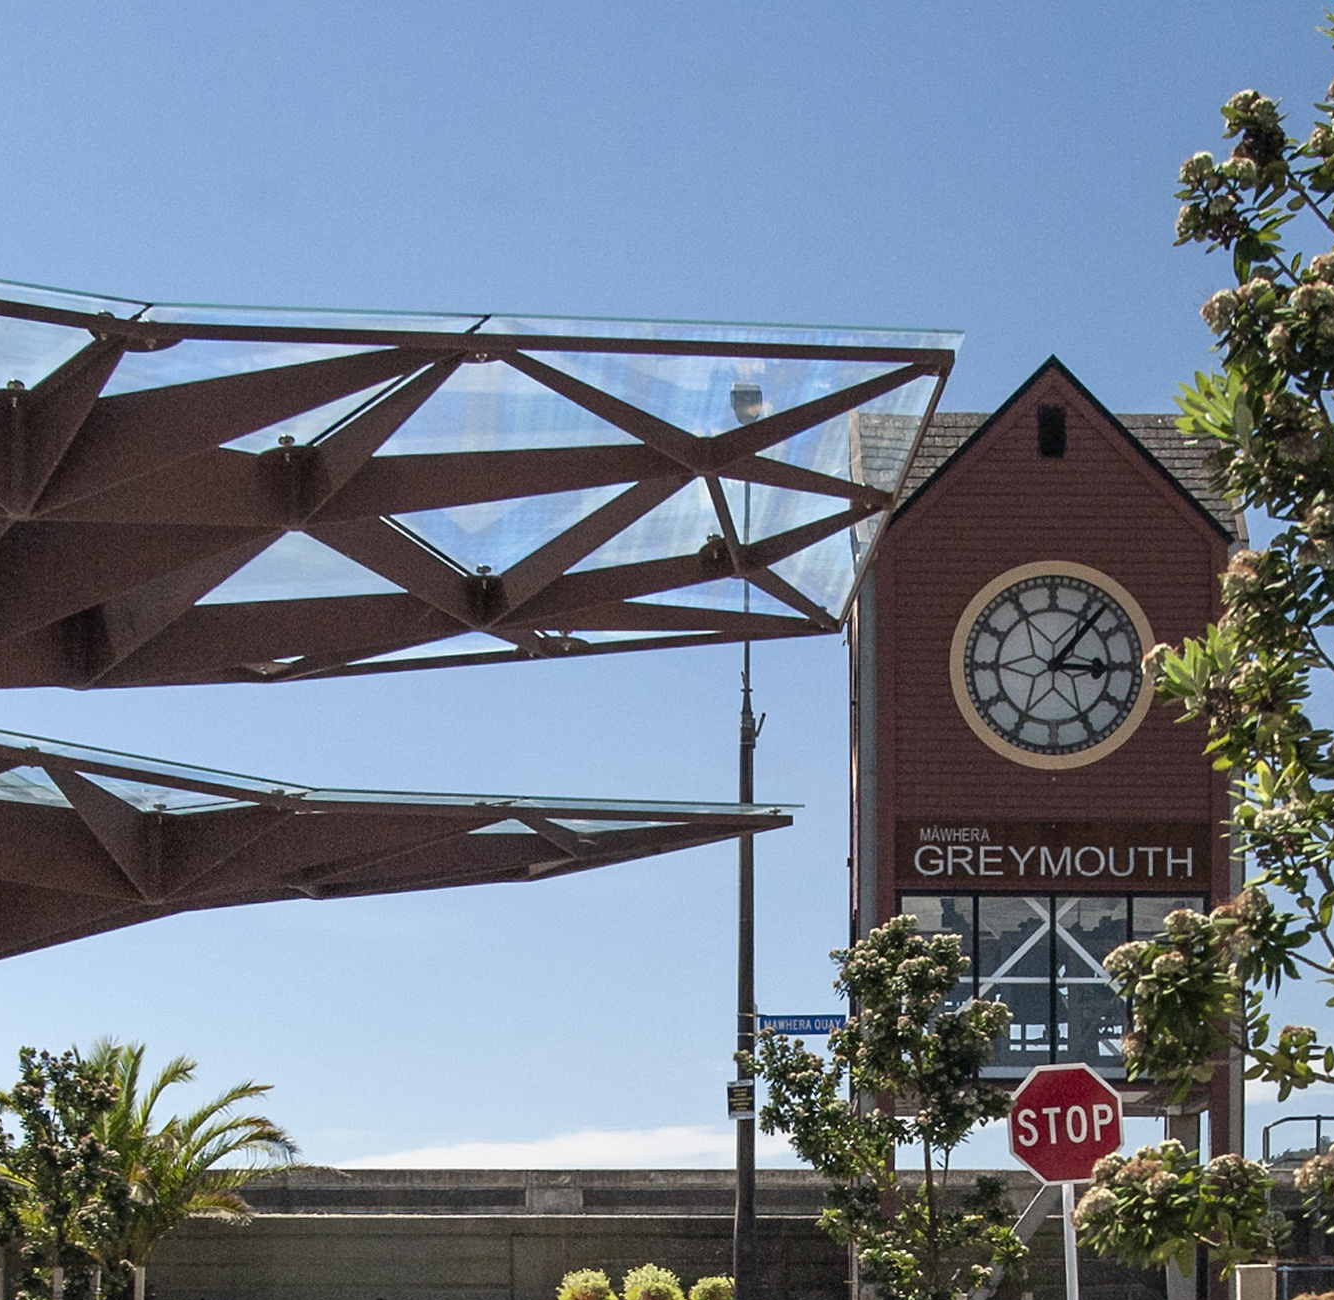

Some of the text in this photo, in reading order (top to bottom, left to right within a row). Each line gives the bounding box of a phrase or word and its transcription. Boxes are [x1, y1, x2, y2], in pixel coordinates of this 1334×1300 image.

[914, 845, 1193, 877] GREYMOUTH
[813, 1018, 841, 1030] QUAY
[1017, 1104, 1113, 1147] STOP
